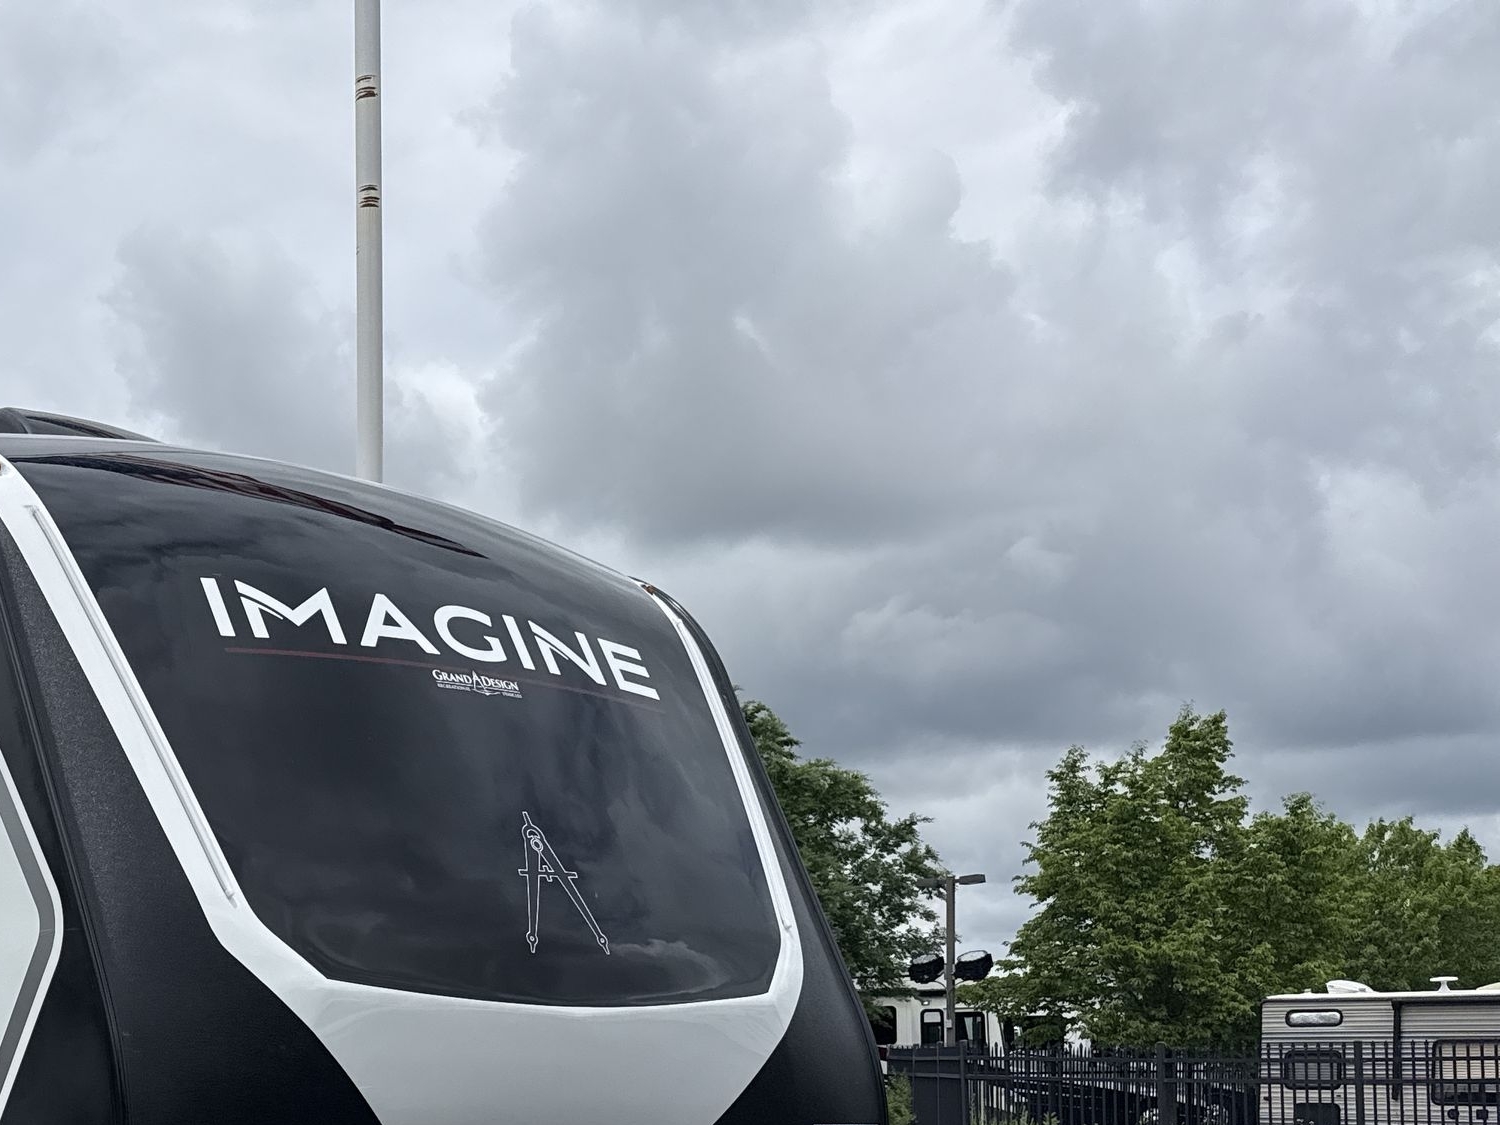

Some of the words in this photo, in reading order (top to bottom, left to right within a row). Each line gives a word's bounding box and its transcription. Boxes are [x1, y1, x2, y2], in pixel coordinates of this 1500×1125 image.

[200, 576, 661, 701] IMAGINE
[432, 669, 473, 684] GRAND
[480, 675, 520, 691] DESIGN
